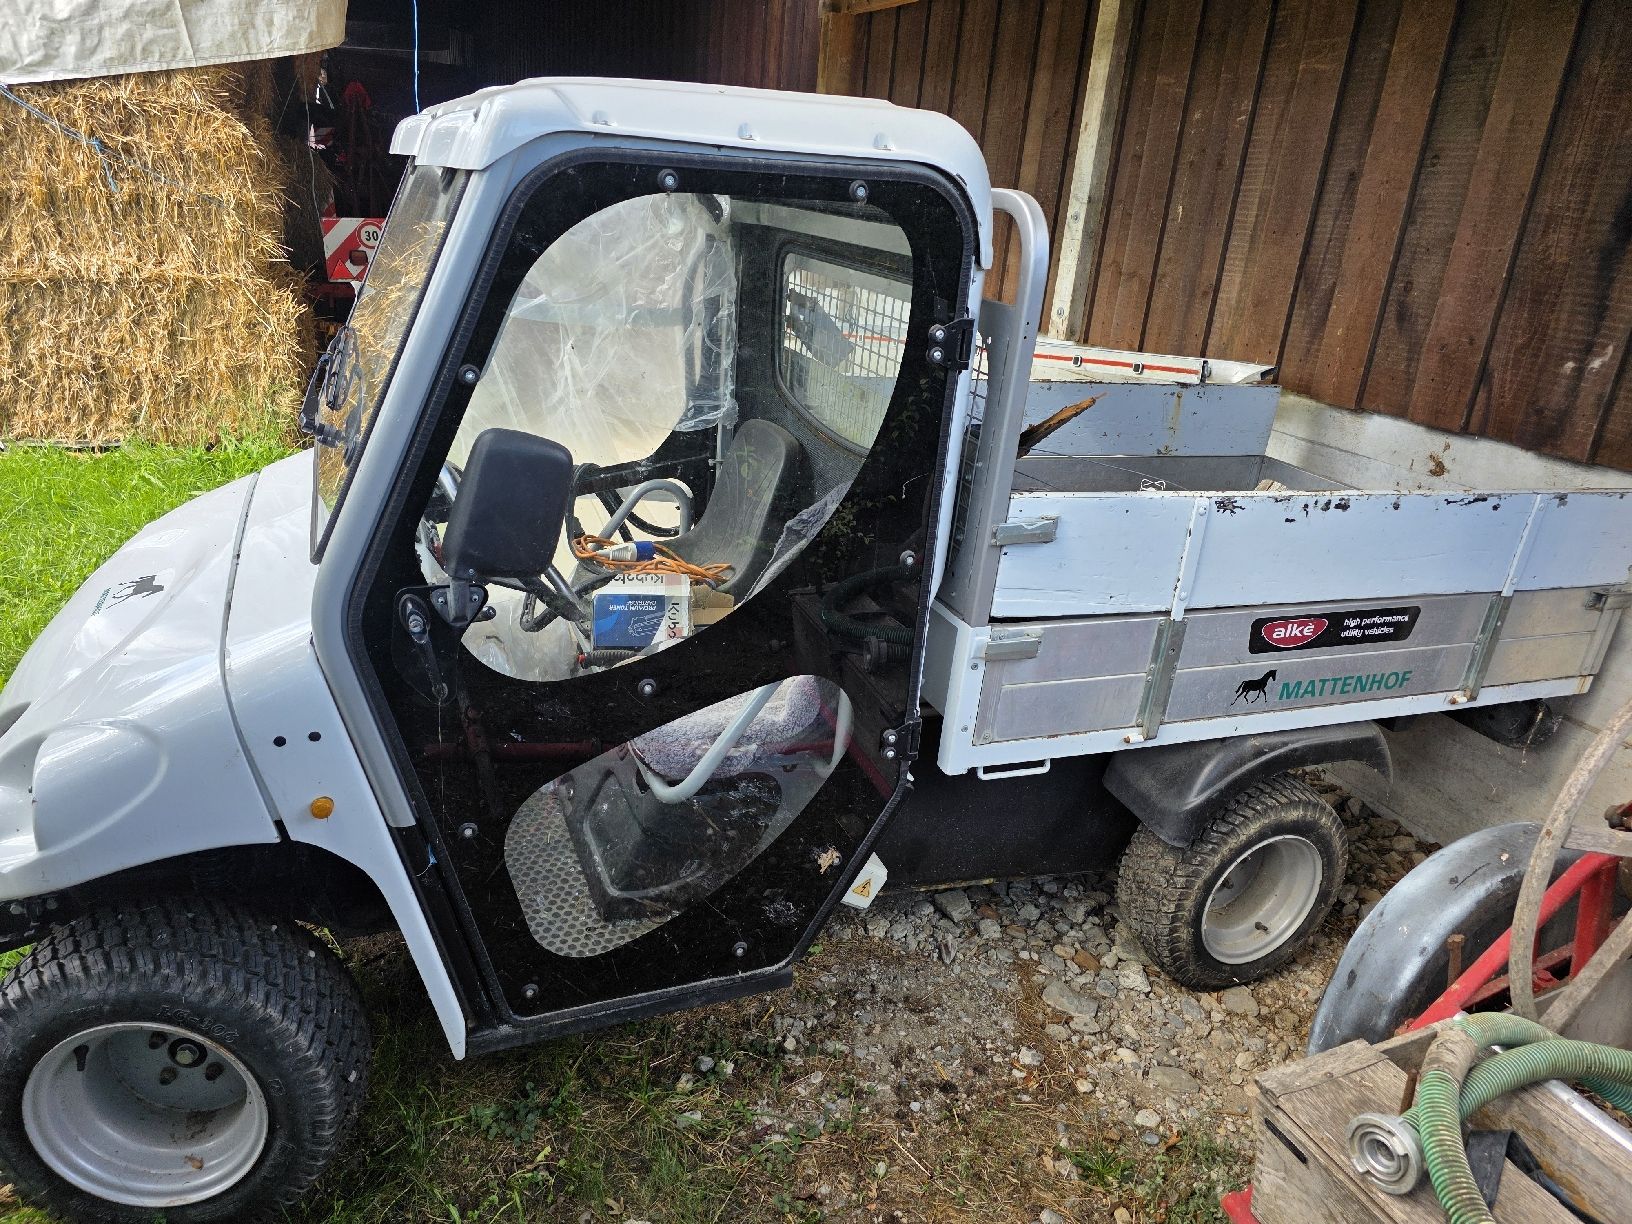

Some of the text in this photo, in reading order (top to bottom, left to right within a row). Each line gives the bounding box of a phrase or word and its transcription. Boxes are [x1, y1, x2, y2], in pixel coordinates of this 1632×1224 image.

[365, 230, 379, 241] 30
[1344, 614, 1410, 628] high performance
[1272, 622, 1315, 639] alkè
[1341, 627, 1394, 638] utility vehicles
[1278, 670, 1413, 700] MATTENHOF
